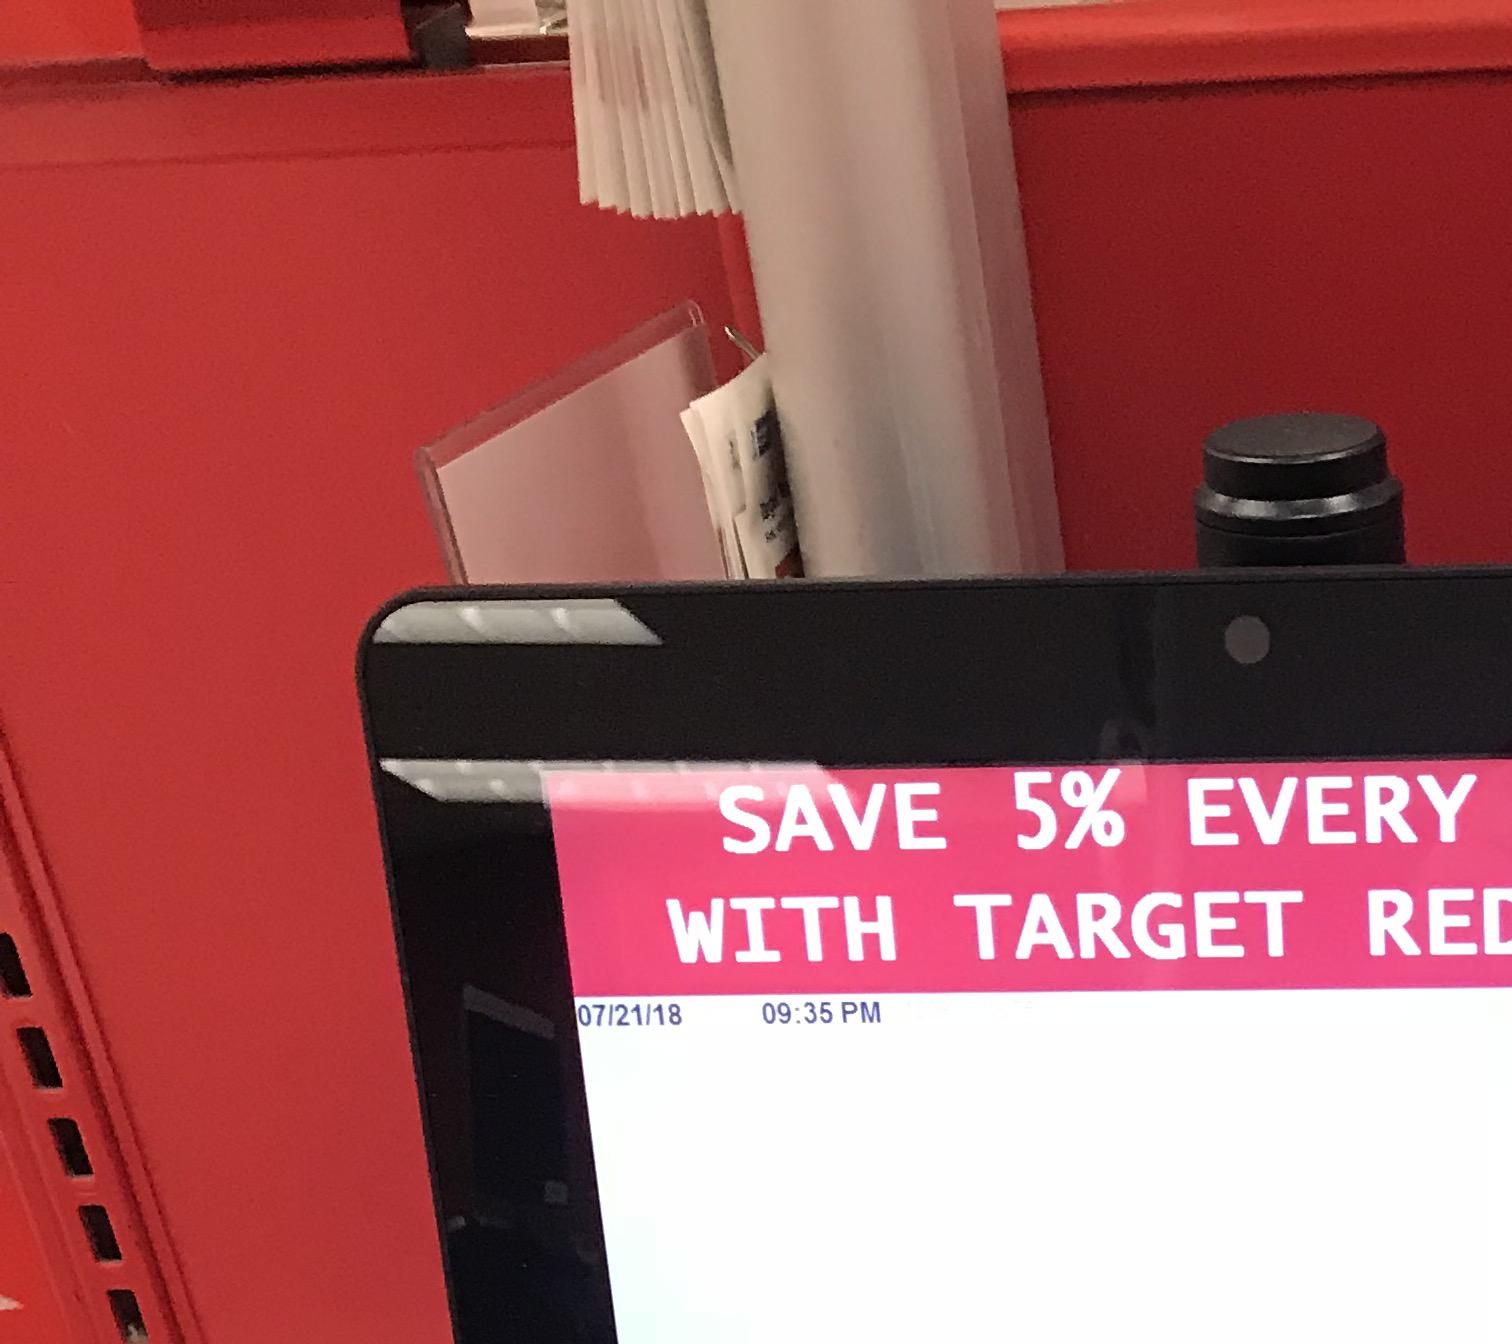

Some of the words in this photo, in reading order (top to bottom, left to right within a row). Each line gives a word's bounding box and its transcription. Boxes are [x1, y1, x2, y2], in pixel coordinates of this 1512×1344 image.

[720, 778, 948, 856] SAVE
[1012, 768, 1127, 851] 5%
[1187, 773, 1478, 846] EVERY
[665, 894, 898, 964] WITH
[952, 889, 1304, 961] TARGET
[577, 1003, 683, 1027] 07/21/18
[762, 1001, 834, 1025] 09:35
[841, 1001, 882, 1023] PM
